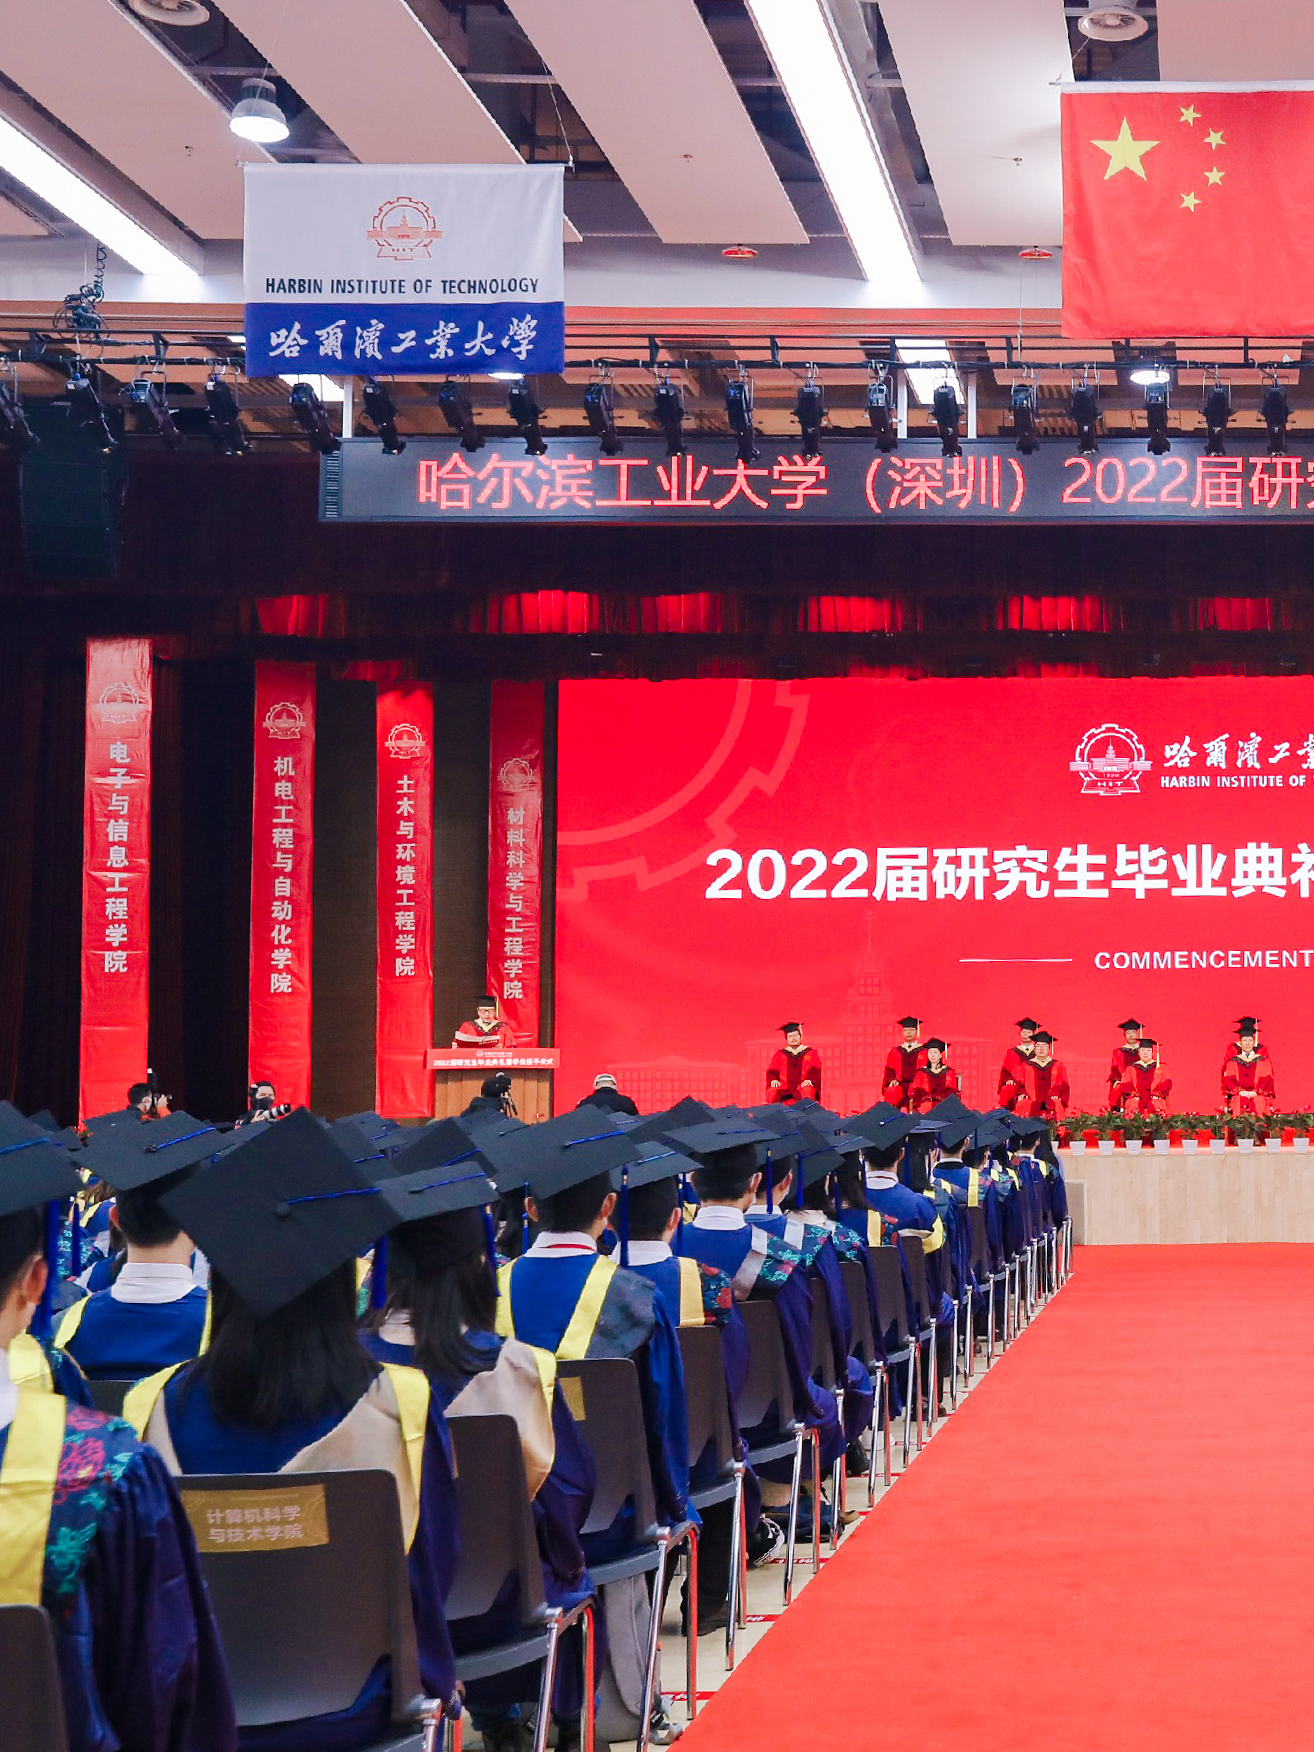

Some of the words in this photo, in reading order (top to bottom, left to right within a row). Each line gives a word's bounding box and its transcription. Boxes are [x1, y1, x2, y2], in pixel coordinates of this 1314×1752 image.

[266, 278, 322, 294] HARBIN
[331, 279, 405, 295] INSTITUTE
[413, 279, 432, 294] OF
[441, 277, 539, 294] TECHNOLOGY
[1160, 775, 1210, 788] HARBIN
[1216, 775, 1283, 788] INSTITUTE
[1288, 775, 1306, 787] OF
[103, 741, 130, 974] 电子与信息工程学院
[270, 756, 295, 994] 机电工程与自动化学院
[395, 775, 416, 977] 土木与环境工程学院
[503, 807, 526, 1000] 材料科学与工程学院
[1094, 949, 1314, 970] COMMENCEMENT
[206, 1505, 301, 1524] 计算机科学
[208, 1524, 304, 1542] 与技术学院
